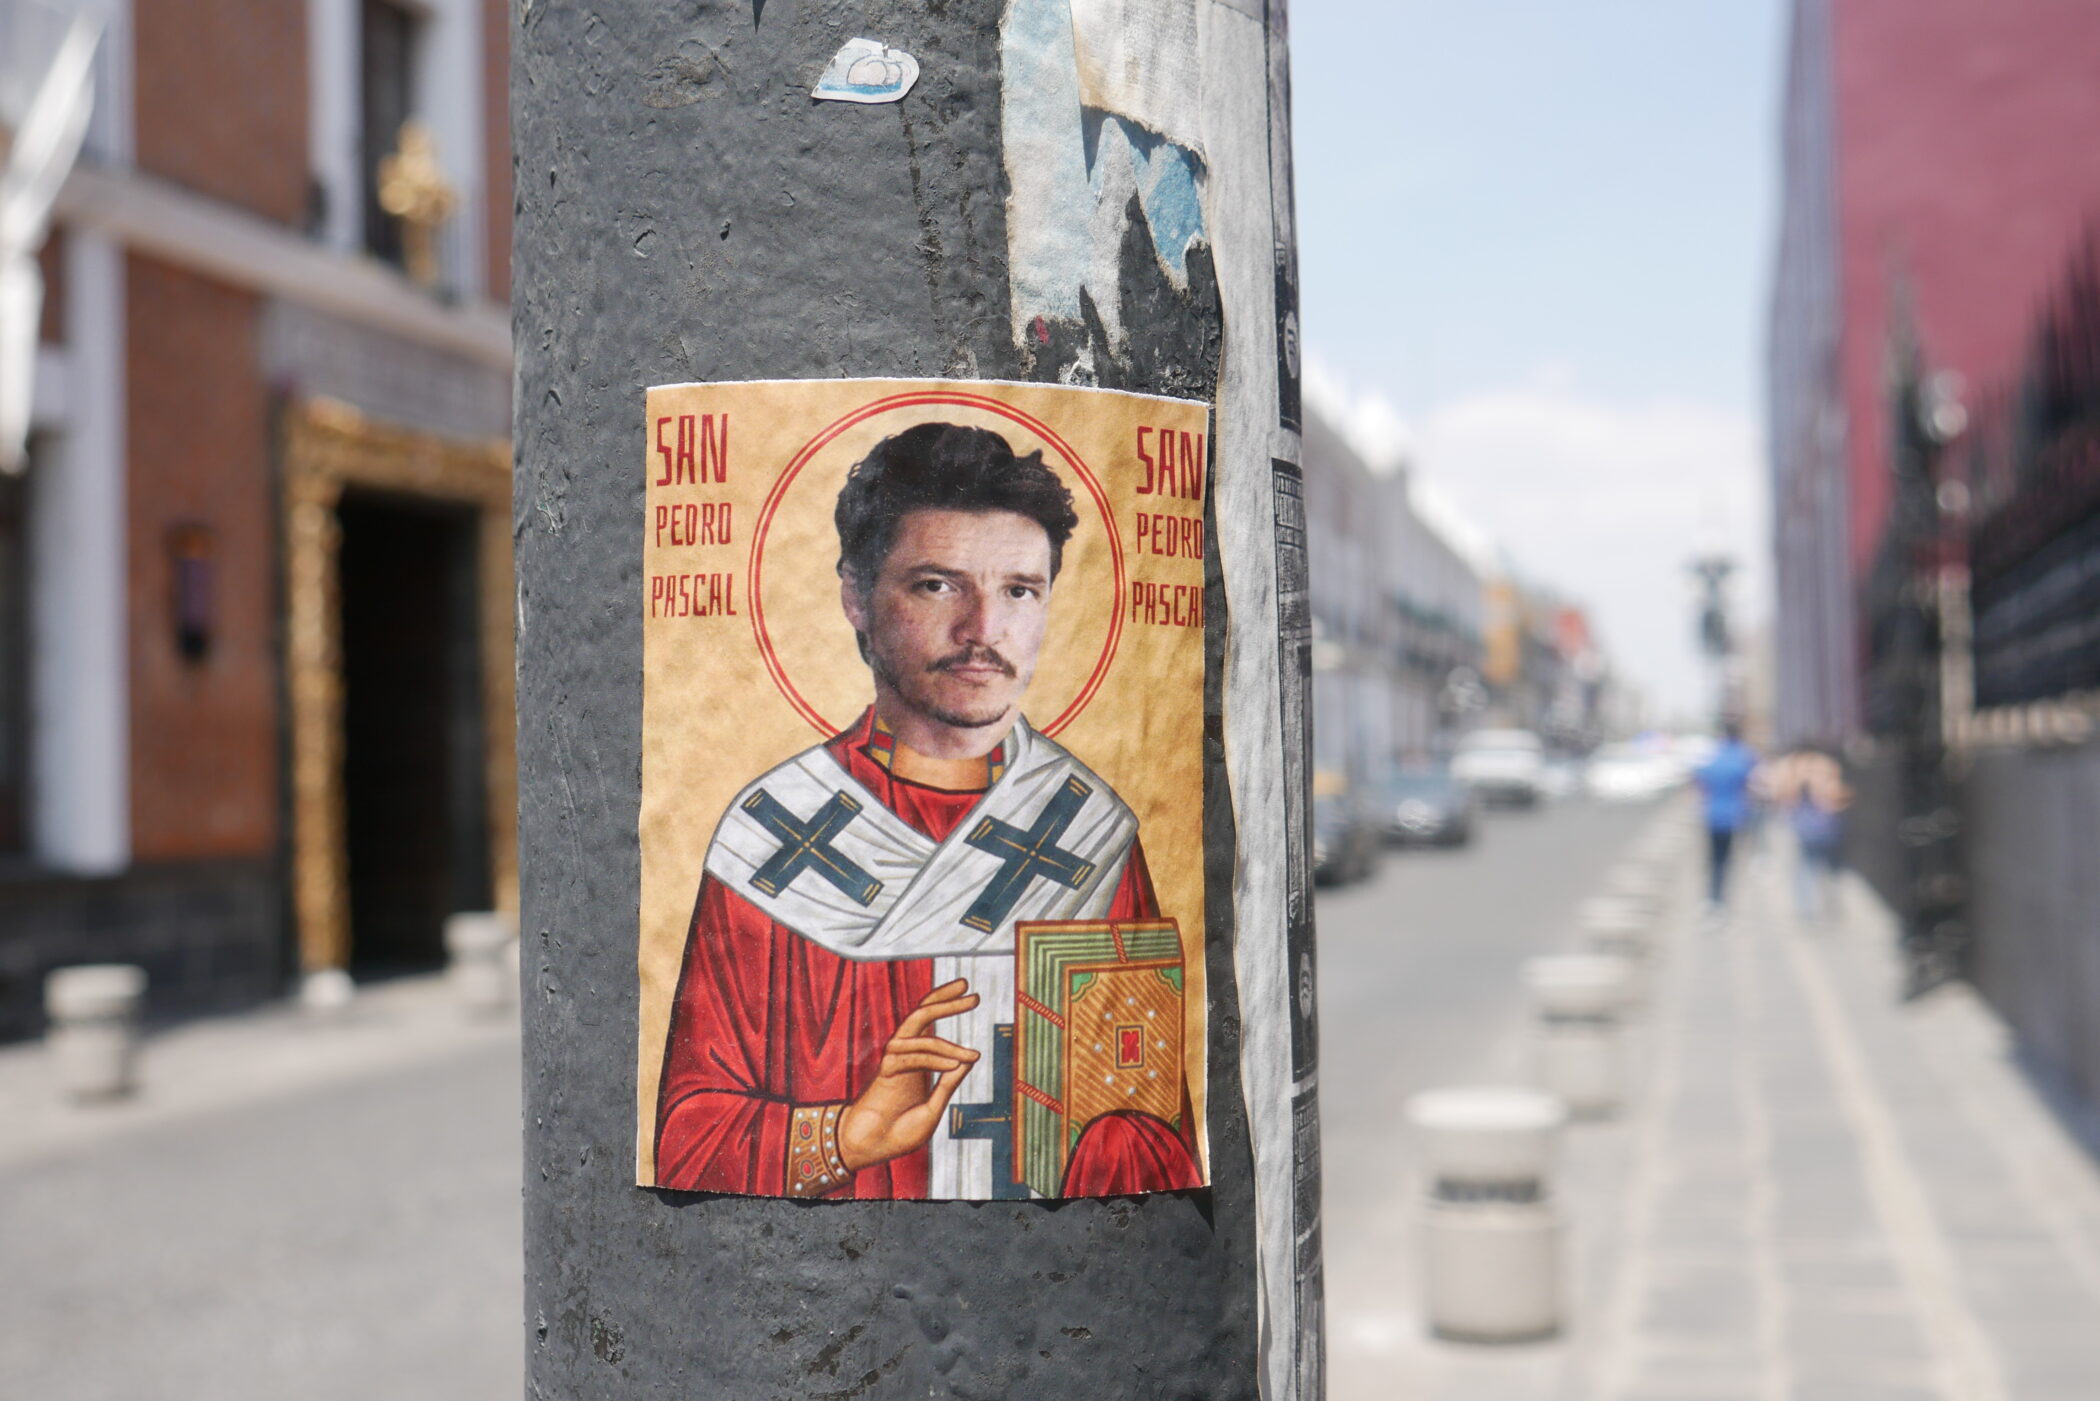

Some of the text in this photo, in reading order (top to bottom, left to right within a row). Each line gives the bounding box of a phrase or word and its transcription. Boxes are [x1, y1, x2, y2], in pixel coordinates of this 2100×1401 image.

[656, 413, 728, 487] SAN
[1136, 426, 1203, 501] SAN
[656, 502, 732, 548] PEDRO
[1136, 512, 1204, 560] PEDRO
[651, 573, 737, 618] PASCAL
